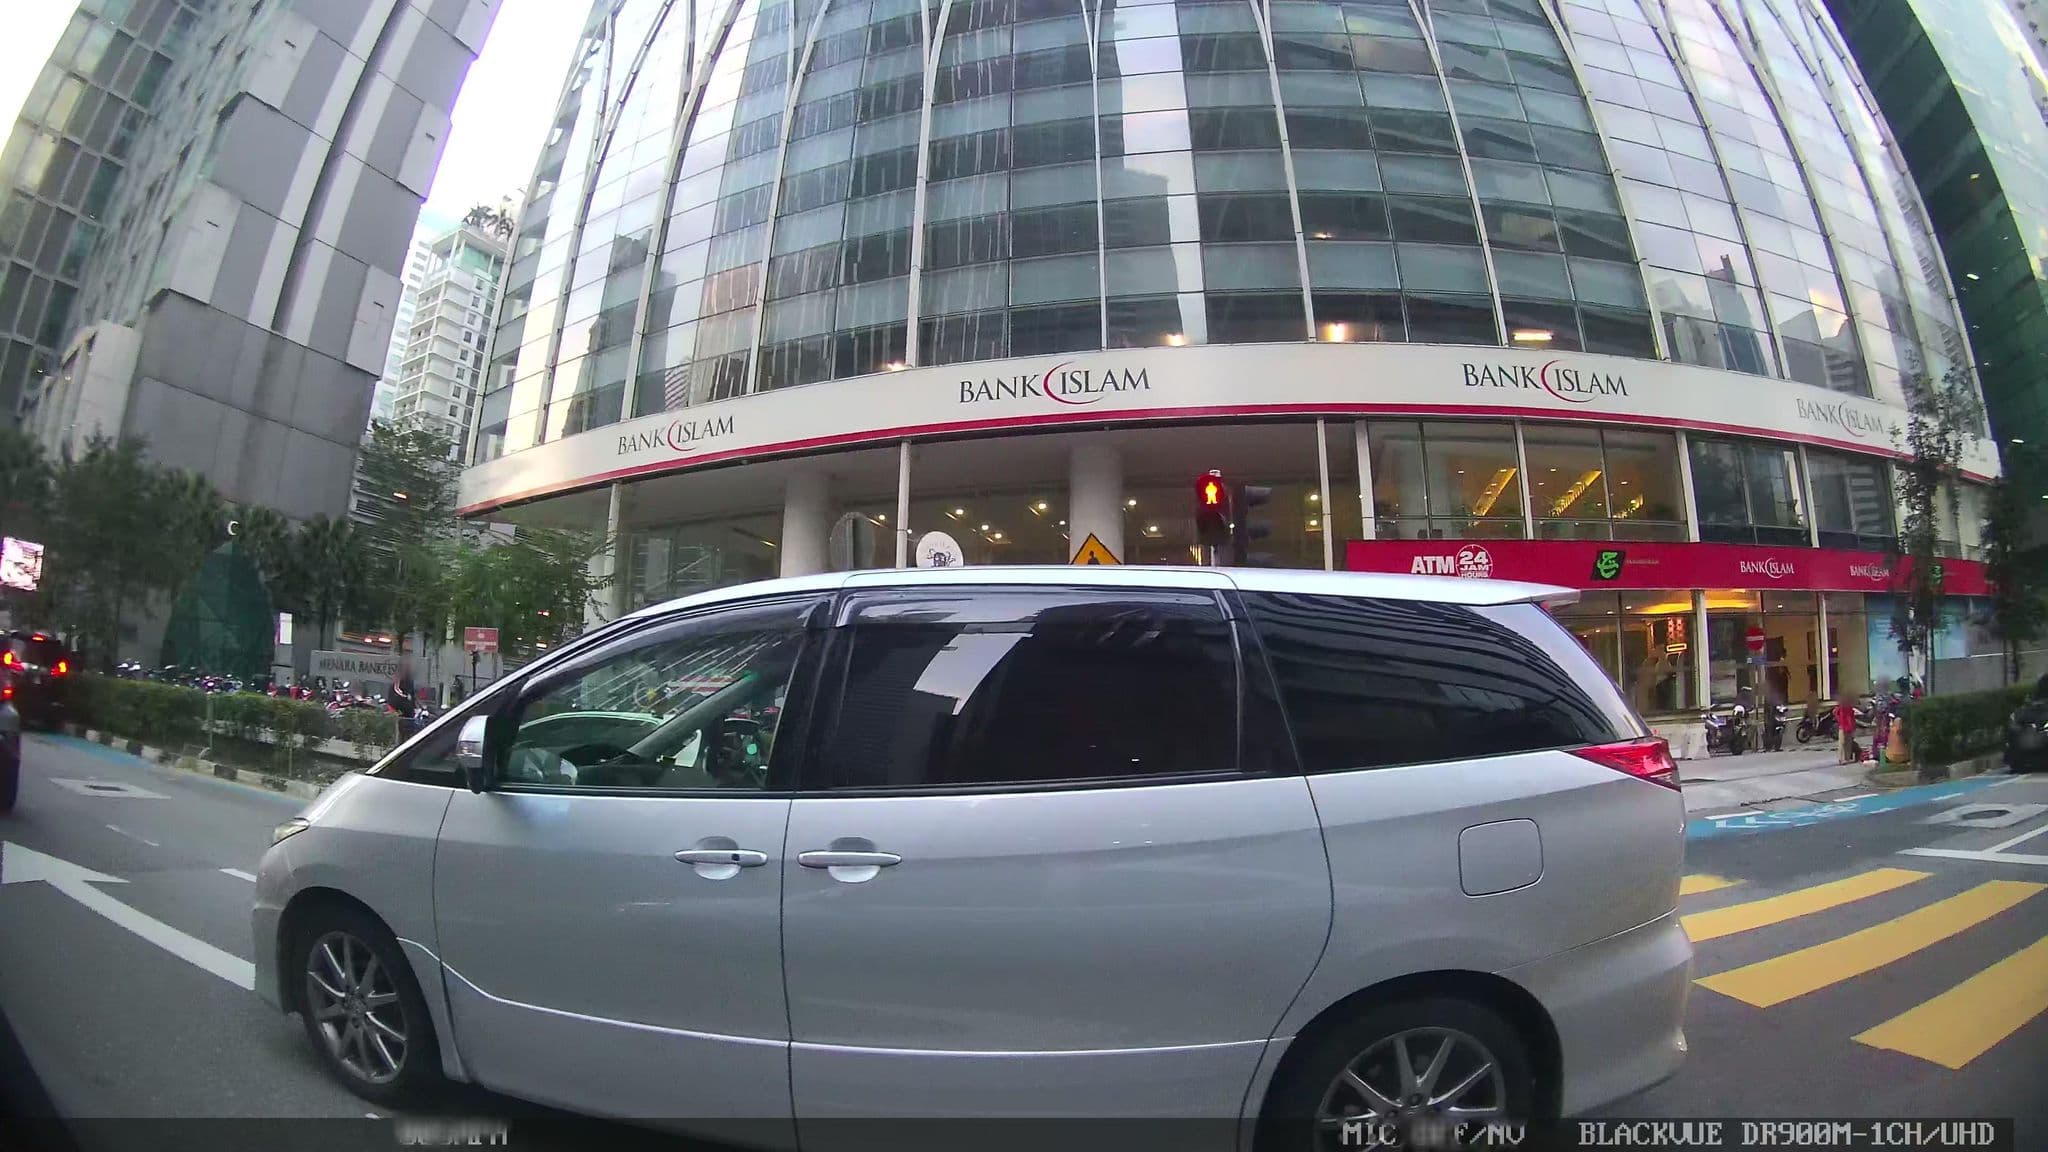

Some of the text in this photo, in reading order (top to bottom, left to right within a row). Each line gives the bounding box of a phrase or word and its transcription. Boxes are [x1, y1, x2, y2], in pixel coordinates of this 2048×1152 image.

[960, 367, 1151, 404] BANK ISLAM
[1463, 363, 1629, 396] BANK ISLAM
[1796, 398, 1884, 434] BANK ISLAM
[618, 415, 734, 455] BANK ISLAM
[1411, 550, 1489, 574] ATM 24
[1740, 561, 1795, 575] BANK ISLAM
[1849, 565, 1871, 576] BANK
